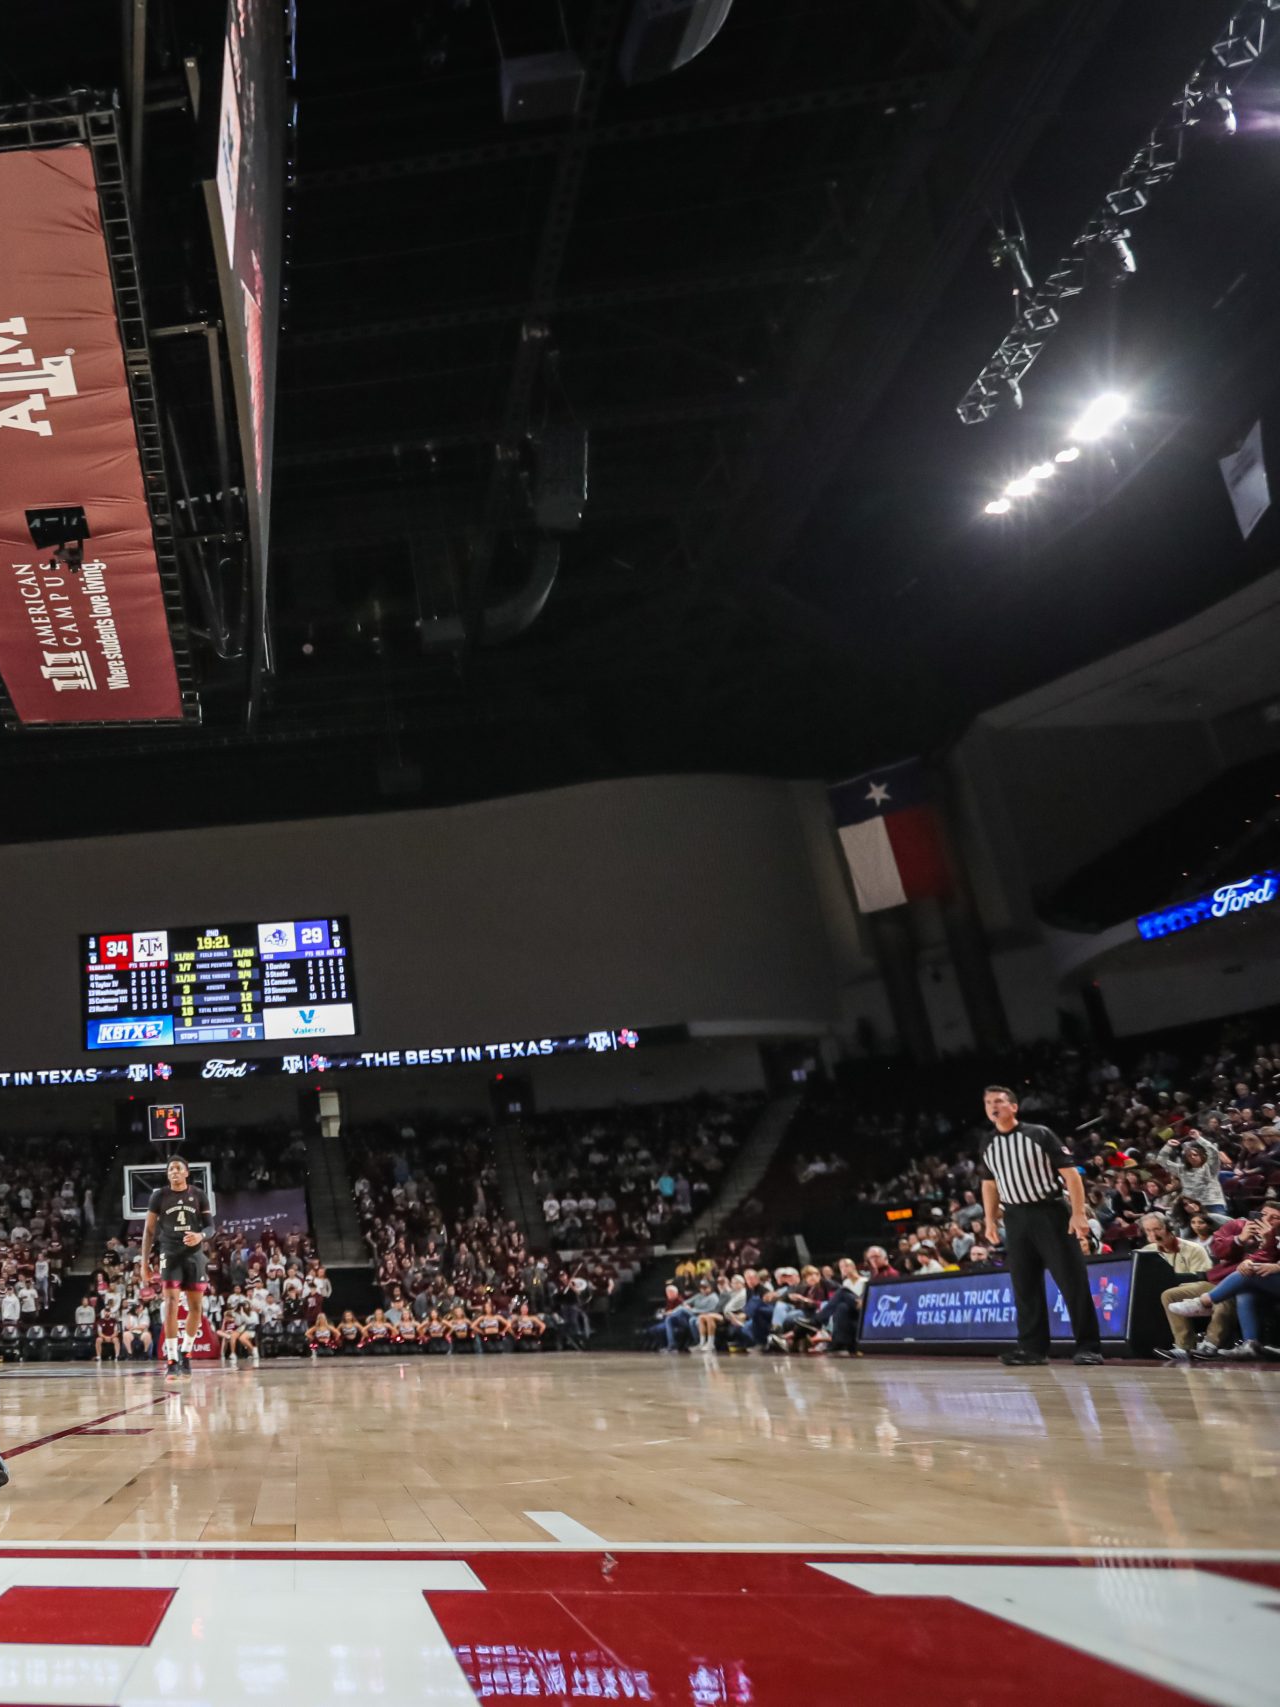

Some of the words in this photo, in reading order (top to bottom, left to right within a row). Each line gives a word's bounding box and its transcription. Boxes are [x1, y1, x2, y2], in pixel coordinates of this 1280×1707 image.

[79, 558, 107, 594] living.
[12, 564, 59, 647] AMERICAN
[89, 595, 113, 618] love
[93, 617, 124, 660] students
[106, 660, 131, 690] Where
[1211, 878, 1274, 917] Ford
[197, 936, 230, 950] 19:21
[301, 927, 323, 944] 29
[106, 941, 128, 957] 34
[179, 963, 191, 971] 1/7
[242, 981, 249, 990] 7
[181, 996, 193, 1005] 12
[241, 992, 252, 1001] 12
[242, 1003, 252, 1012] 11
[101, 1025, 145, 1040] KBTX
[247, 1027, 256, 1038] 4
[14, 1071, 33, 1086] IN
[37, 1068, 98, 1085] TEXAS
[201, 1059, 248, 1079] Ford
[361, 1053, 400, 1068] THE
[405, 1049, 453, 1066] BEST
[461, 1047, 481, 1062] IN
[485, 1039, 554, 1060] TEXAS
[166, 1117, 179, 1137] 5
[177, 1211, 186, 1225] 4
[872, 1294, 908, 1327] Ford
[918, 1292, 961, 1308] OFFICIAL
[963, 1289, 1001, 1305] TRUCK
[1002, 1288, 1011, 1303] &
[916, 1310, 947, 1325] TEXAS
[948, 1308, 972, 1323] A&M
